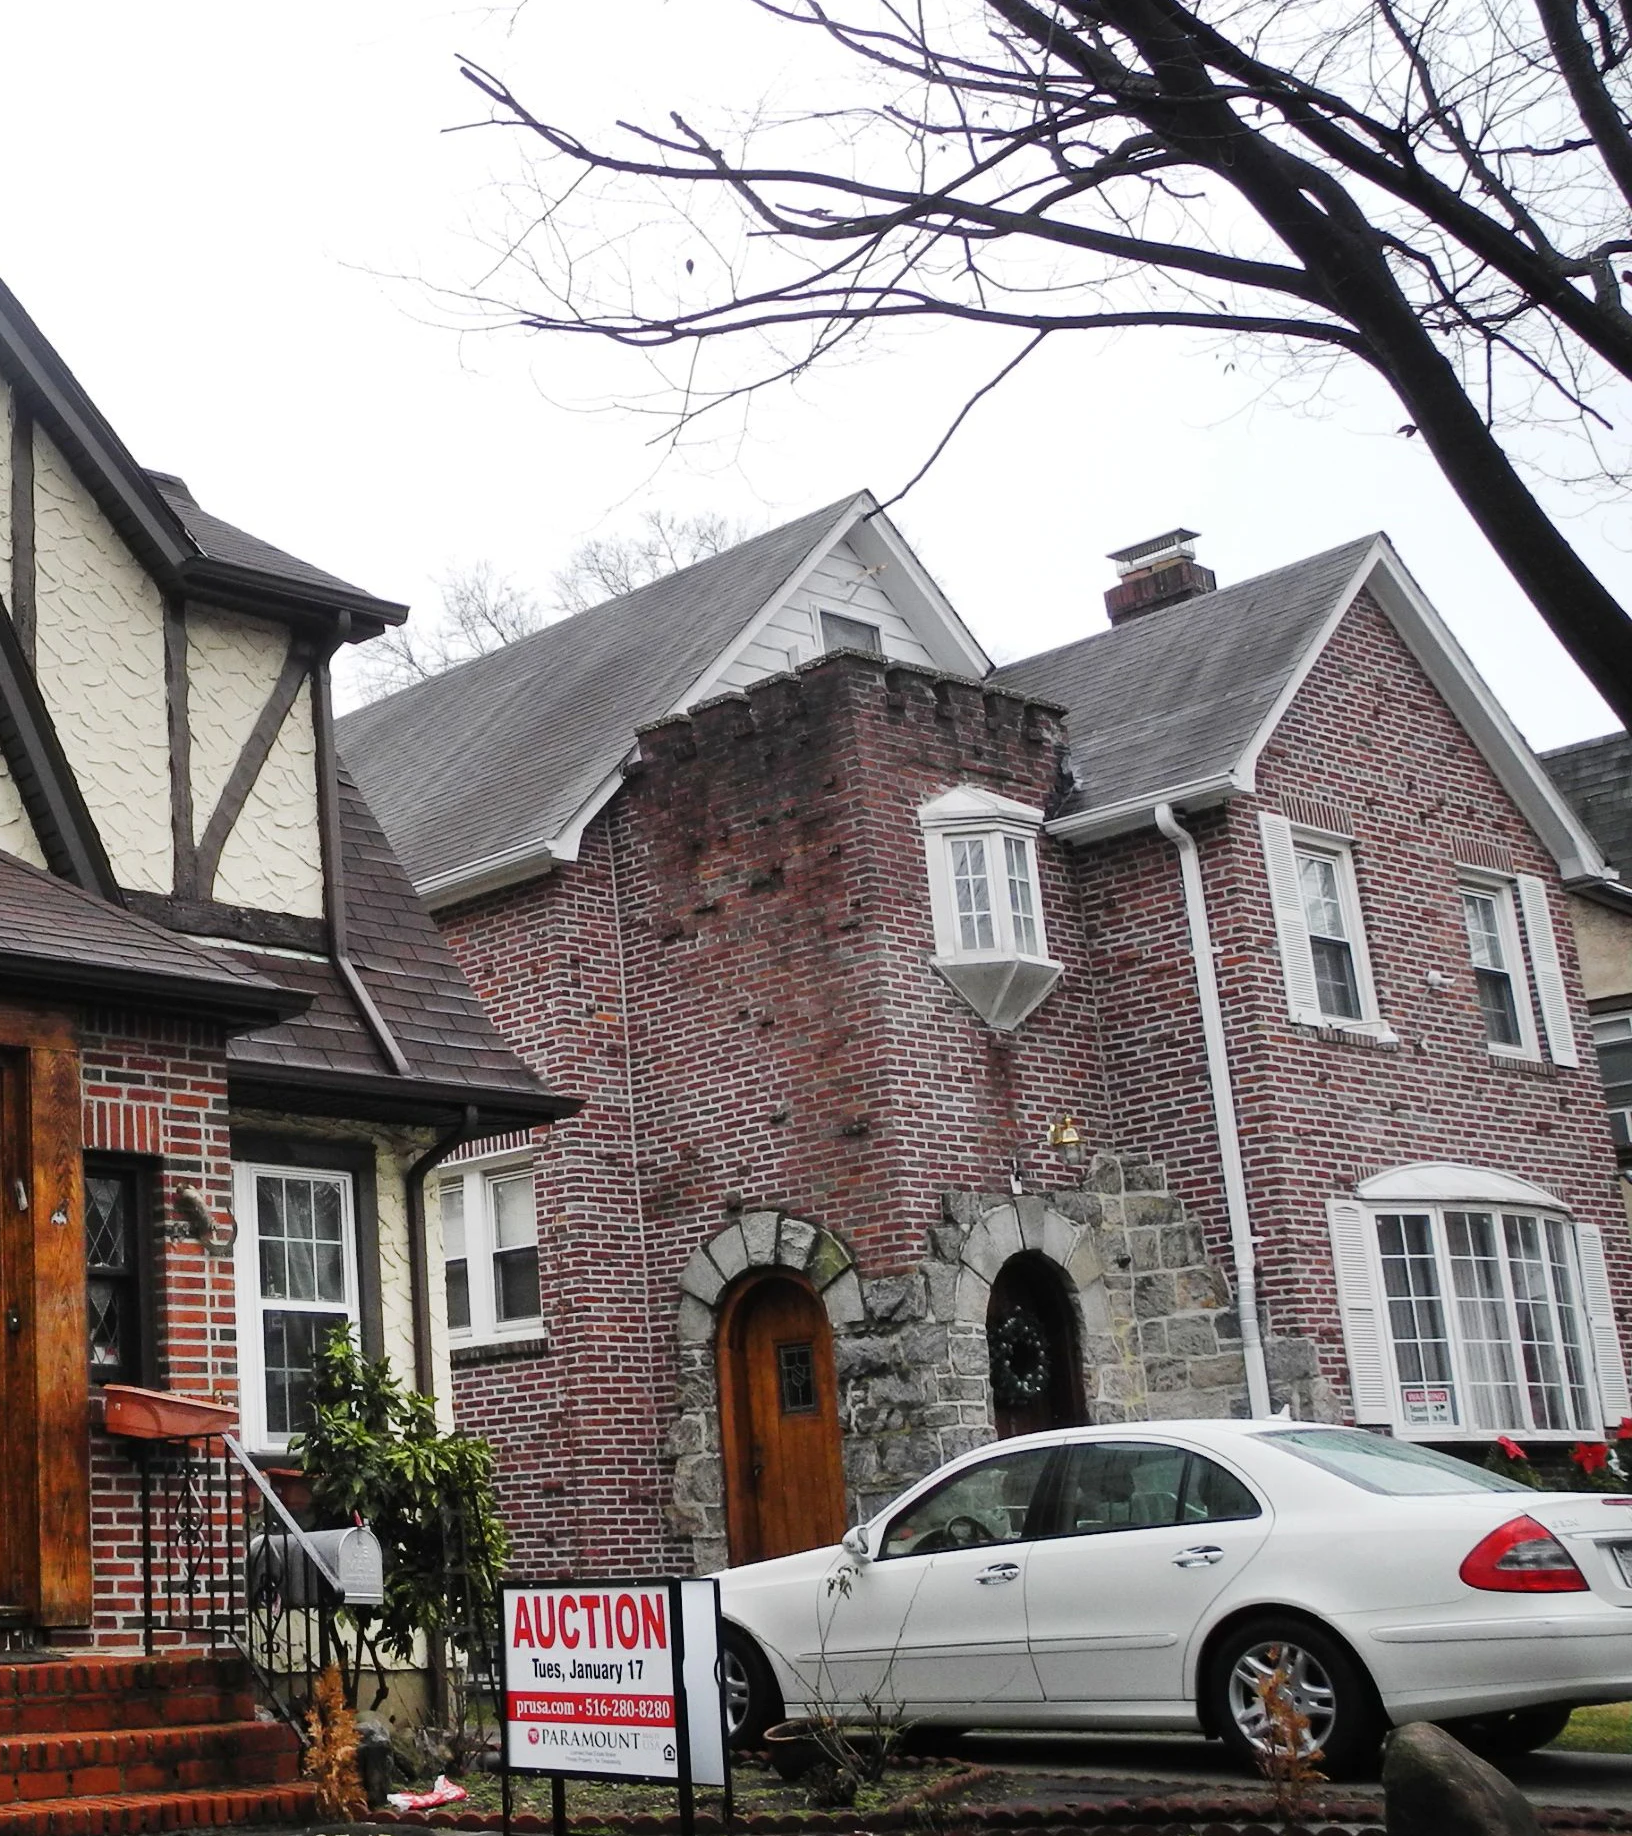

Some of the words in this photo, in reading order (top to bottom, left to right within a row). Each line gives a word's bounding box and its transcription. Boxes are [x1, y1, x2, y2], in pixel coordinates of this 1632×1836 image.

[513, 1593, 667, 1650] AUCTION
[532, 1658, 565, 1682] Tues,
[569, 1659, 622, 1684] January
[628, 1660, 643, 1680] 17
[516, 1700, 575, 1718] prusa.com
[585, 1698, 671, 1719] 516-280-8280
[542, 1729, 640, 1749] PARAMOUNT
